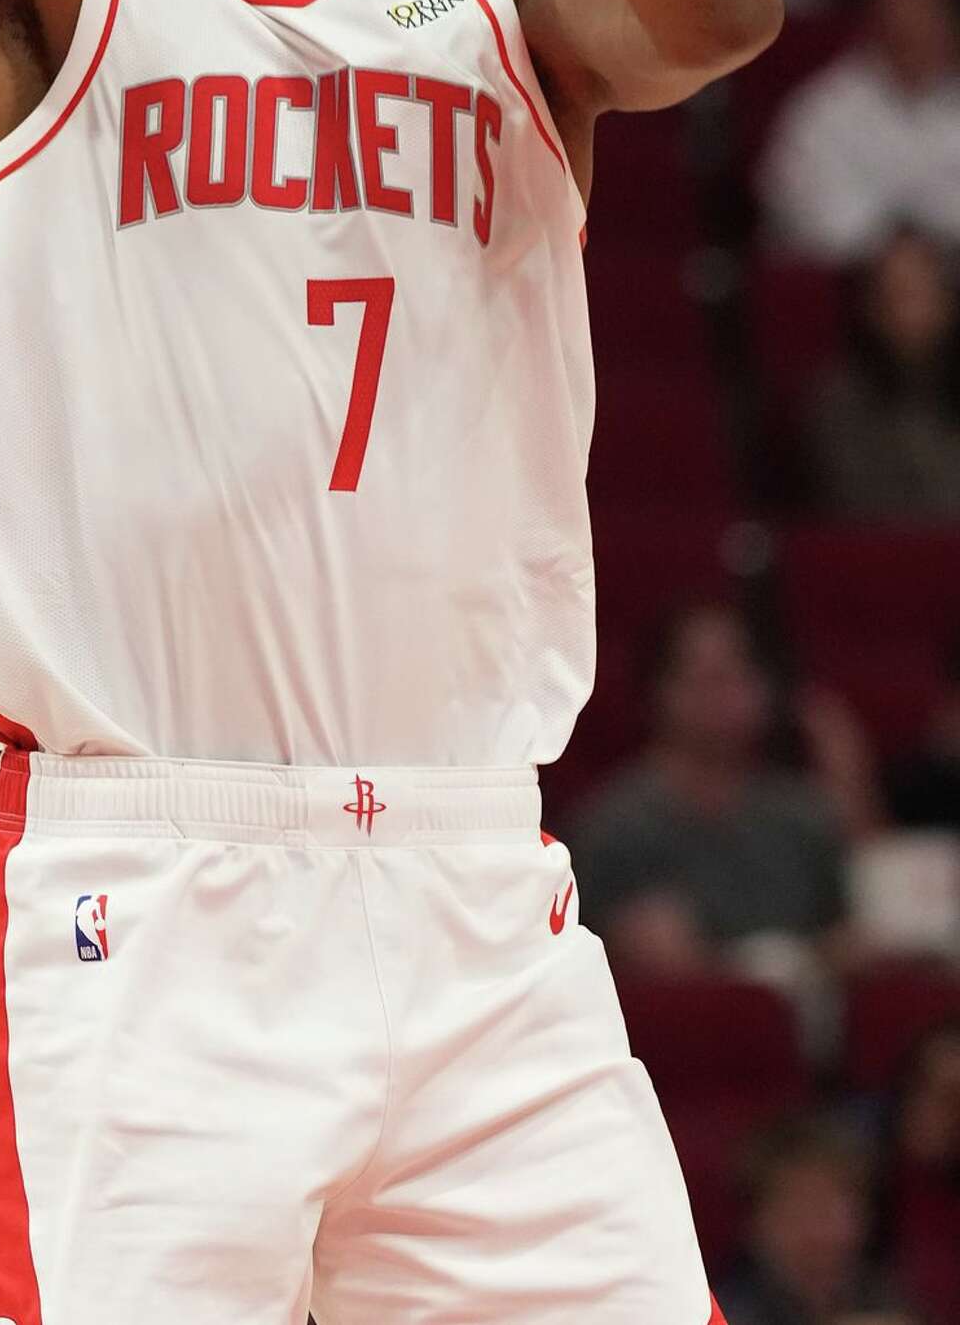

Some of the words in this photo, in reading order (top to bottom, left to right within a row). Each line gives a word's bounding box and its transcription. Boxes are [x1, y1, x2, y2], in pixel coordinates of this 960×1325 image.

[117, 65, 503, 249] ROCKETS
[307, 276, 395, 492] 7
[80, 945, 97, 959] NBA
